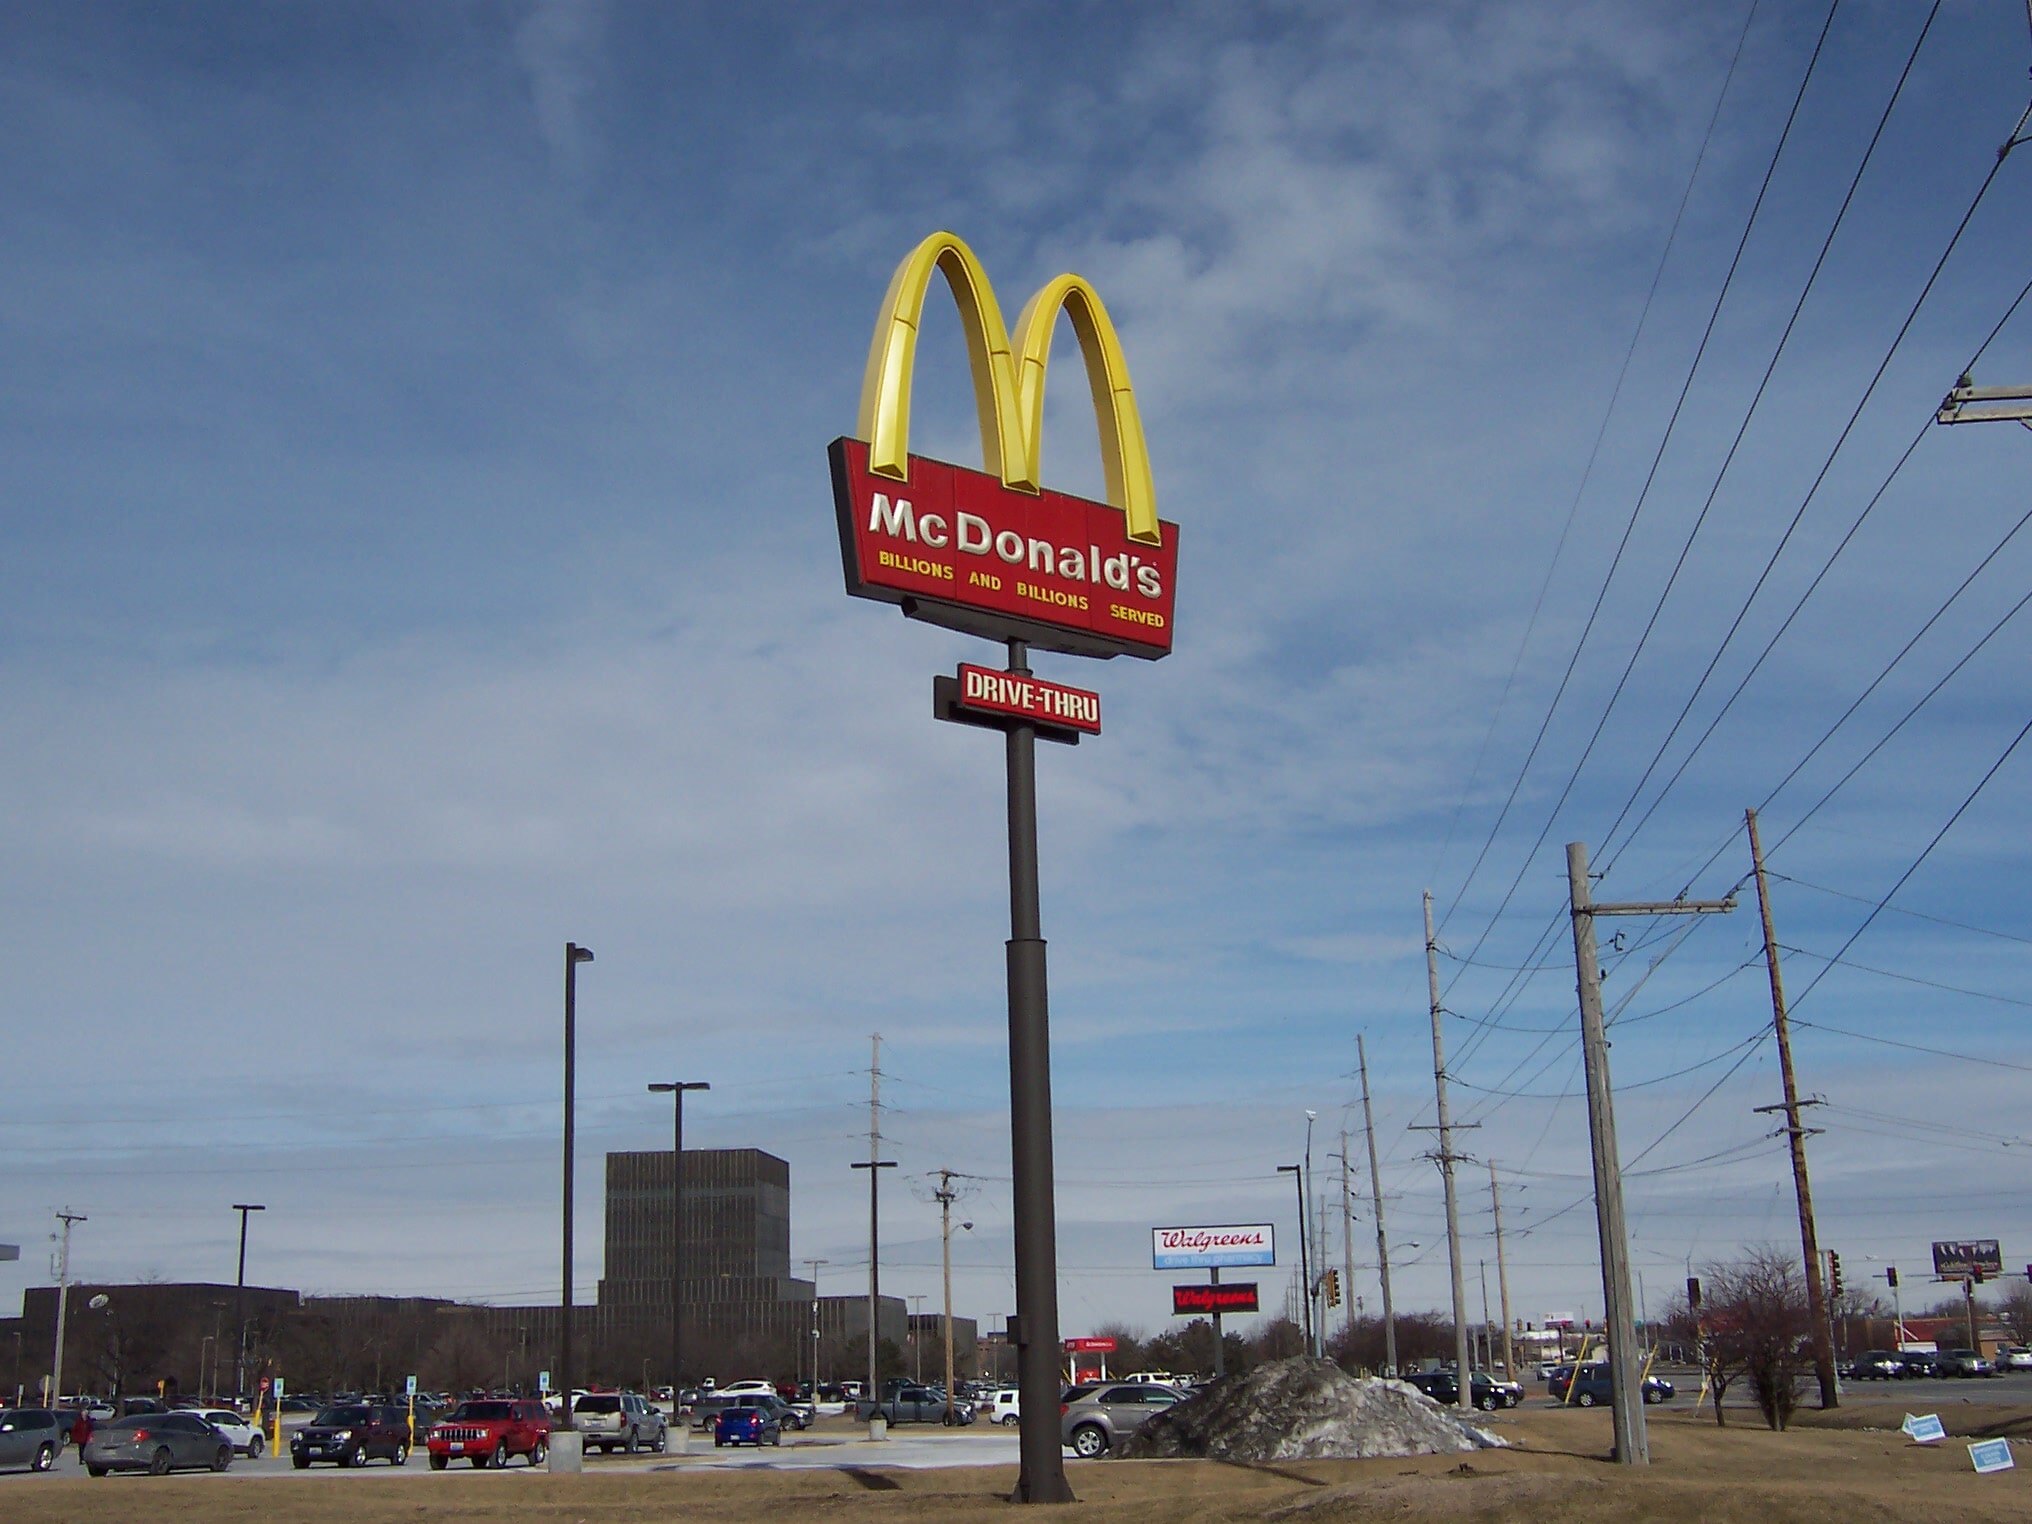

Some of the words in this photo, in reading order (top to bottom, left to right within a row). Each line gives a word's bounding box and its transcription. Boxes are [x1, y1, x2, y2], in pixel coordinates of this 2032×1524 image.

[868, 492, 1162, 599] McDonald's
[879, 550, 954, 580] BILLIONS
[969, 571, 1002, 591] AND
[1016, 582, 1089, 610] BILLIONS
[1110, 604, 1165, 628] SERVED
[967, 671, 1098, 722] DRIVE-THRU
[1161, 1230, 1264, 1253] Walgreens
[1175, 1290, 1255, 1310] Walgreens
